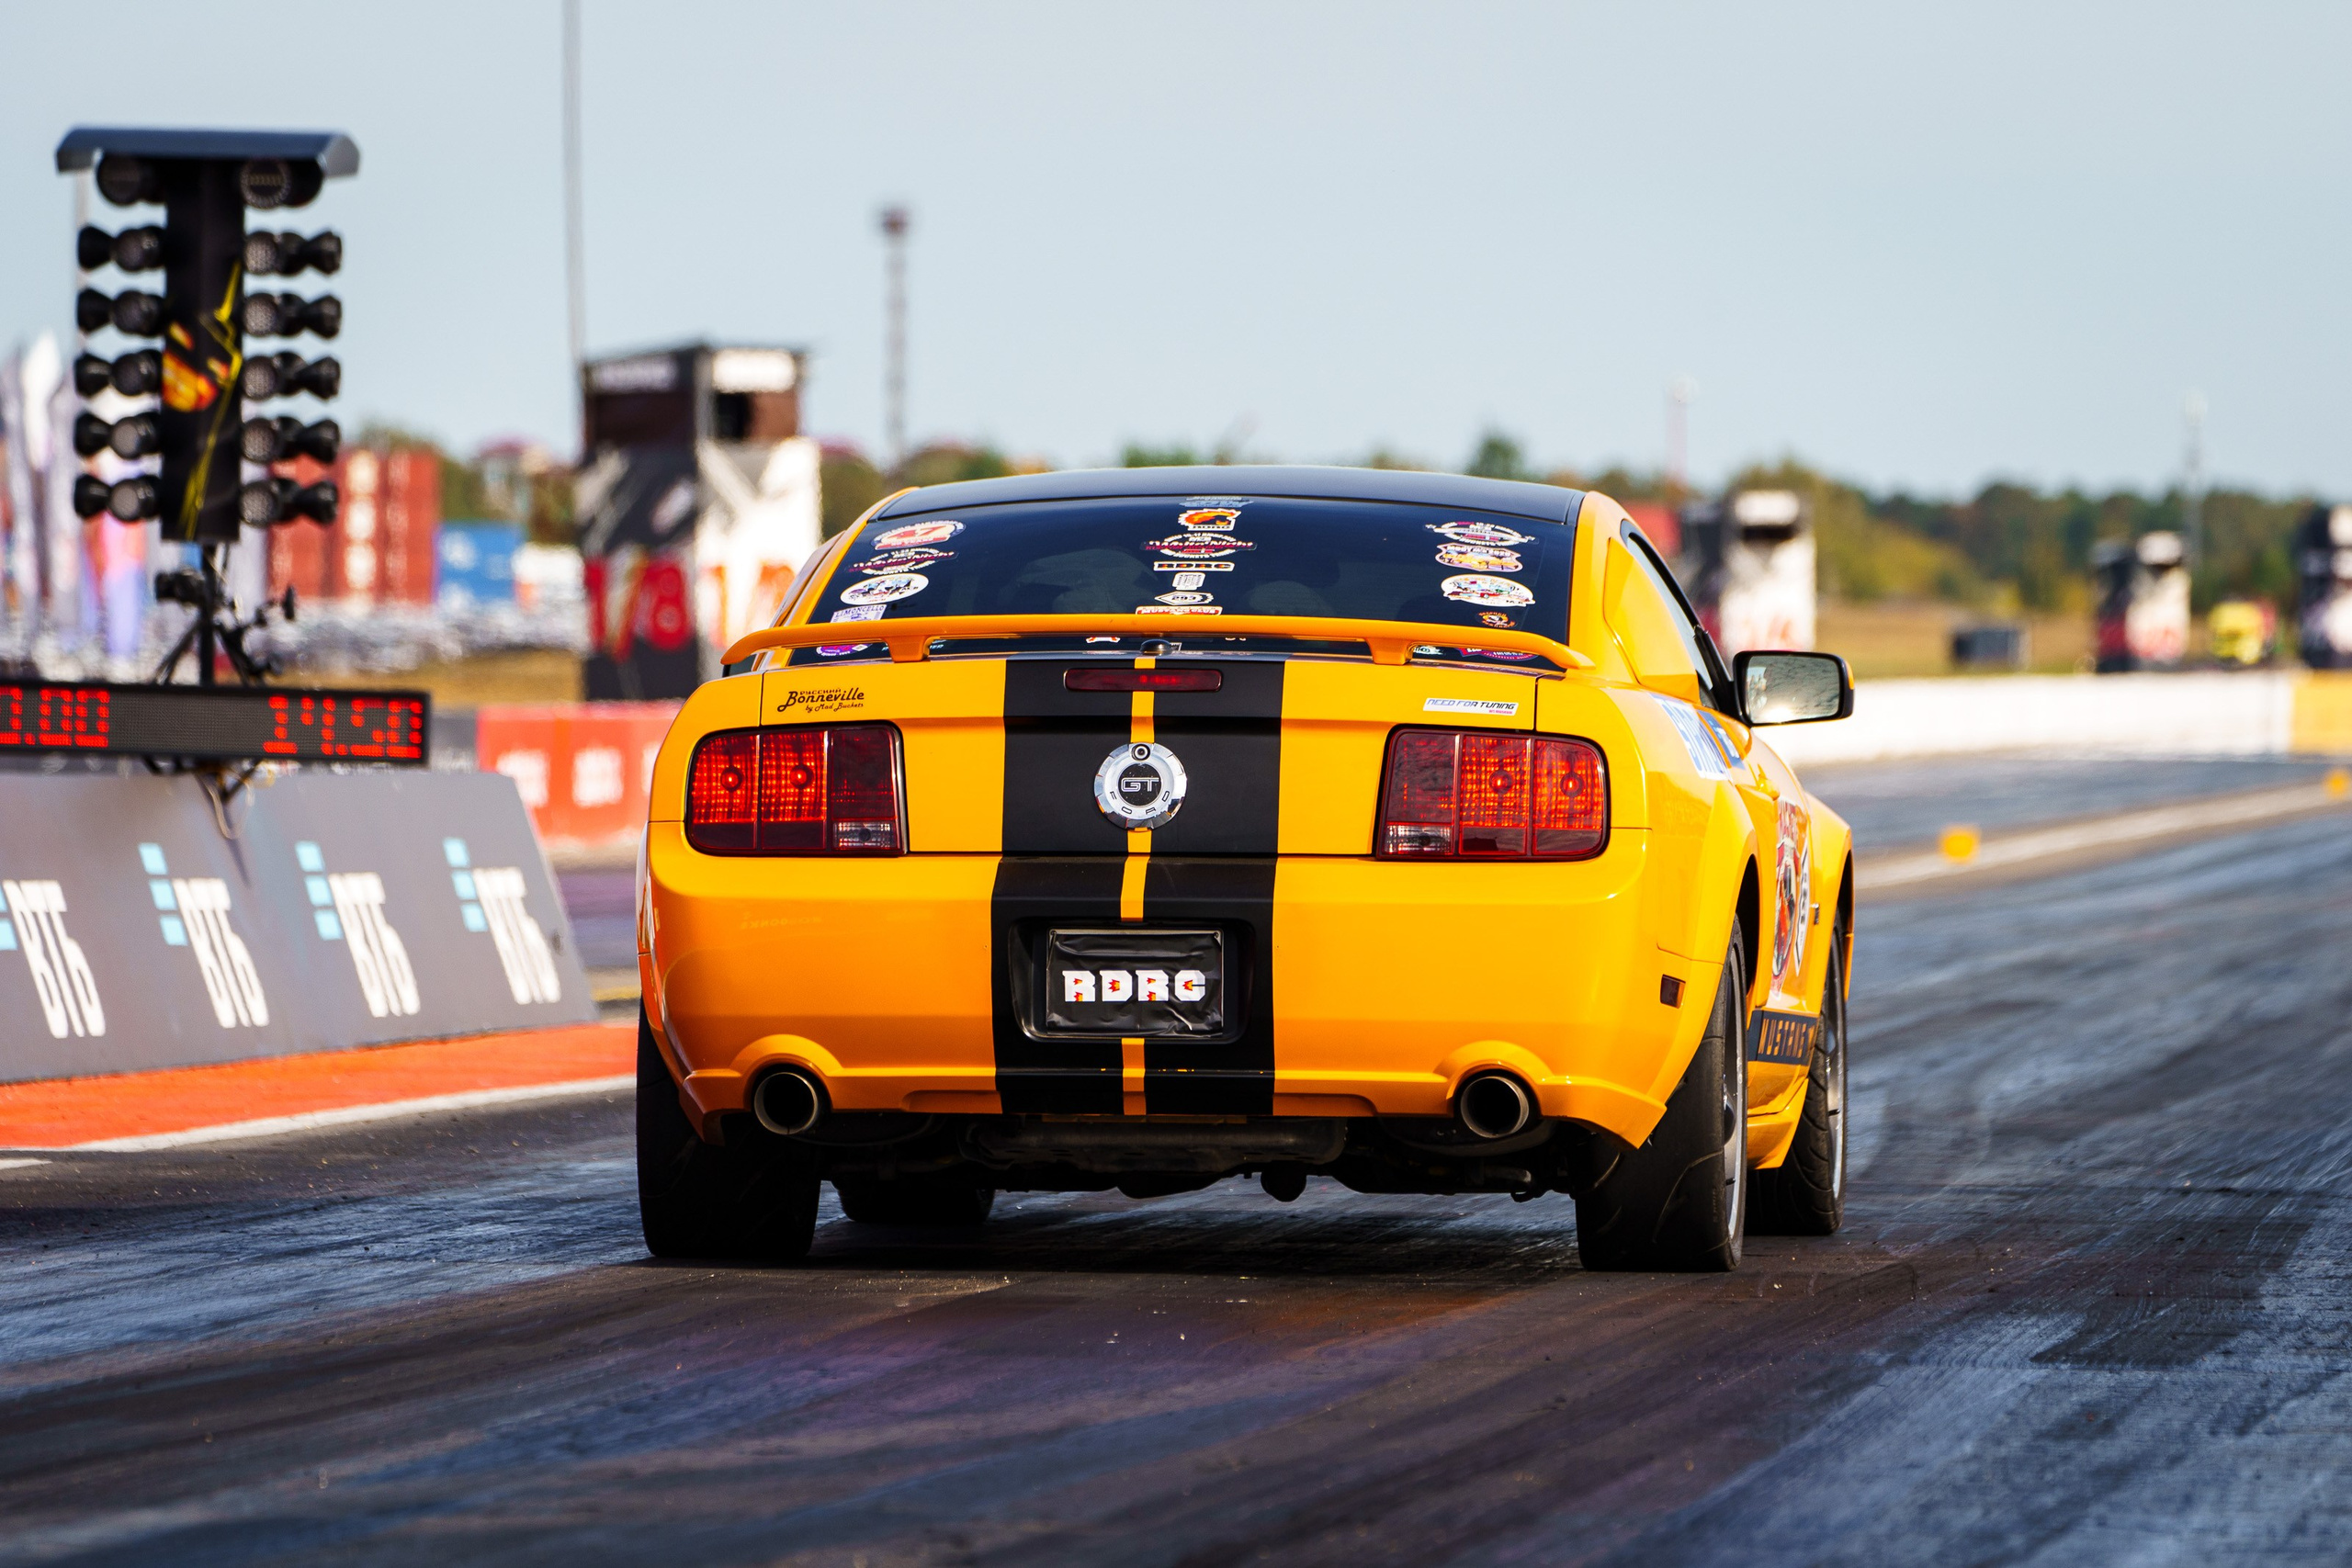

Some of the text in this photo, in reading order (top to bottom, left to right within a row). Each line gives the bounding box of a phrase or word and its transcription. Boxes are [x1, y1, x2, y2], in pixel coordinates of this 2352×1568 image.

[835, 605, 885, 617] LIMONCELLO
[776, 687, 865, 713] Bonneville
[805, 702, 864, 713] by Mad Buckets
[1427, 698, 1455, 706] NEED
[1480, 702, 1516, 710] TUNING
[263, 695, 423, 759] 14.50
[1121, 777, 1159, 792] GT
[1109, 790, 1170, 815] FORD
[1062, 969, 1206, 1002] RDRC
[1758, 1018, 1807, 1058] MUSTANG
